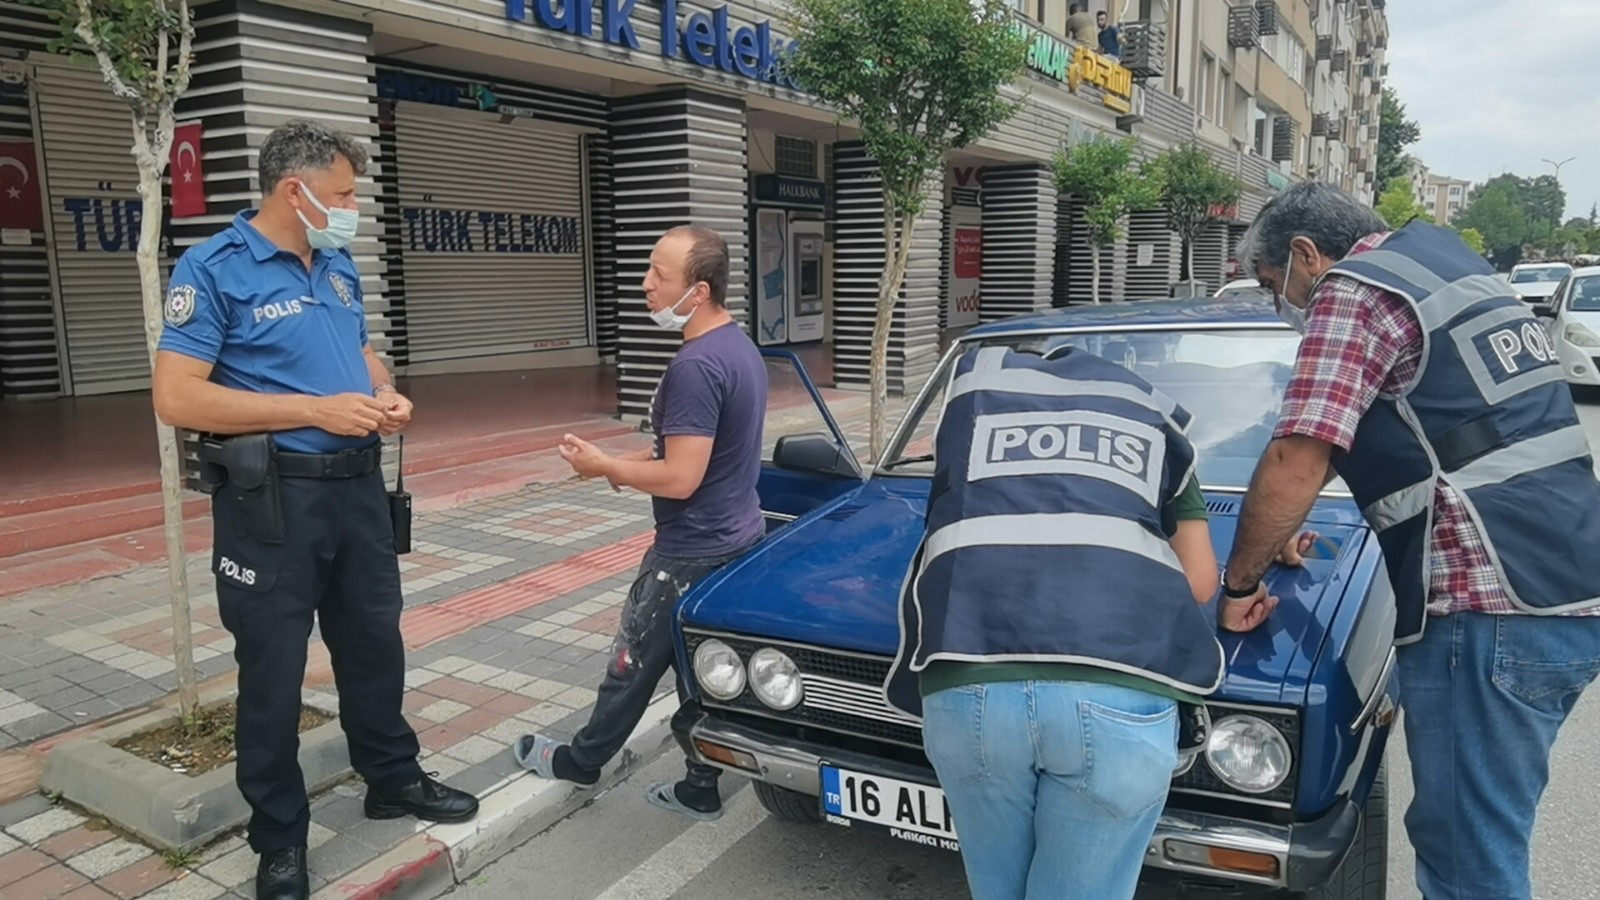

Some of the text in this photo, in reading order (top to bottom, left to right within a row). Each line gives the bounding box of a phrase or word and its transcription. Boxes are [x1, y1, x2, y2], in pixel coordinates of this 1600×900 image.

[778, 183, 821, 199] HALKBANK
[63, 181, 165, 253] TÜR
[403, 194, 578, 254] TÜRK TELEKOM
[826, 792, 840, 806] TR
[845, 776, 881, 817] 16
[940, 839, 960, 851] MU
